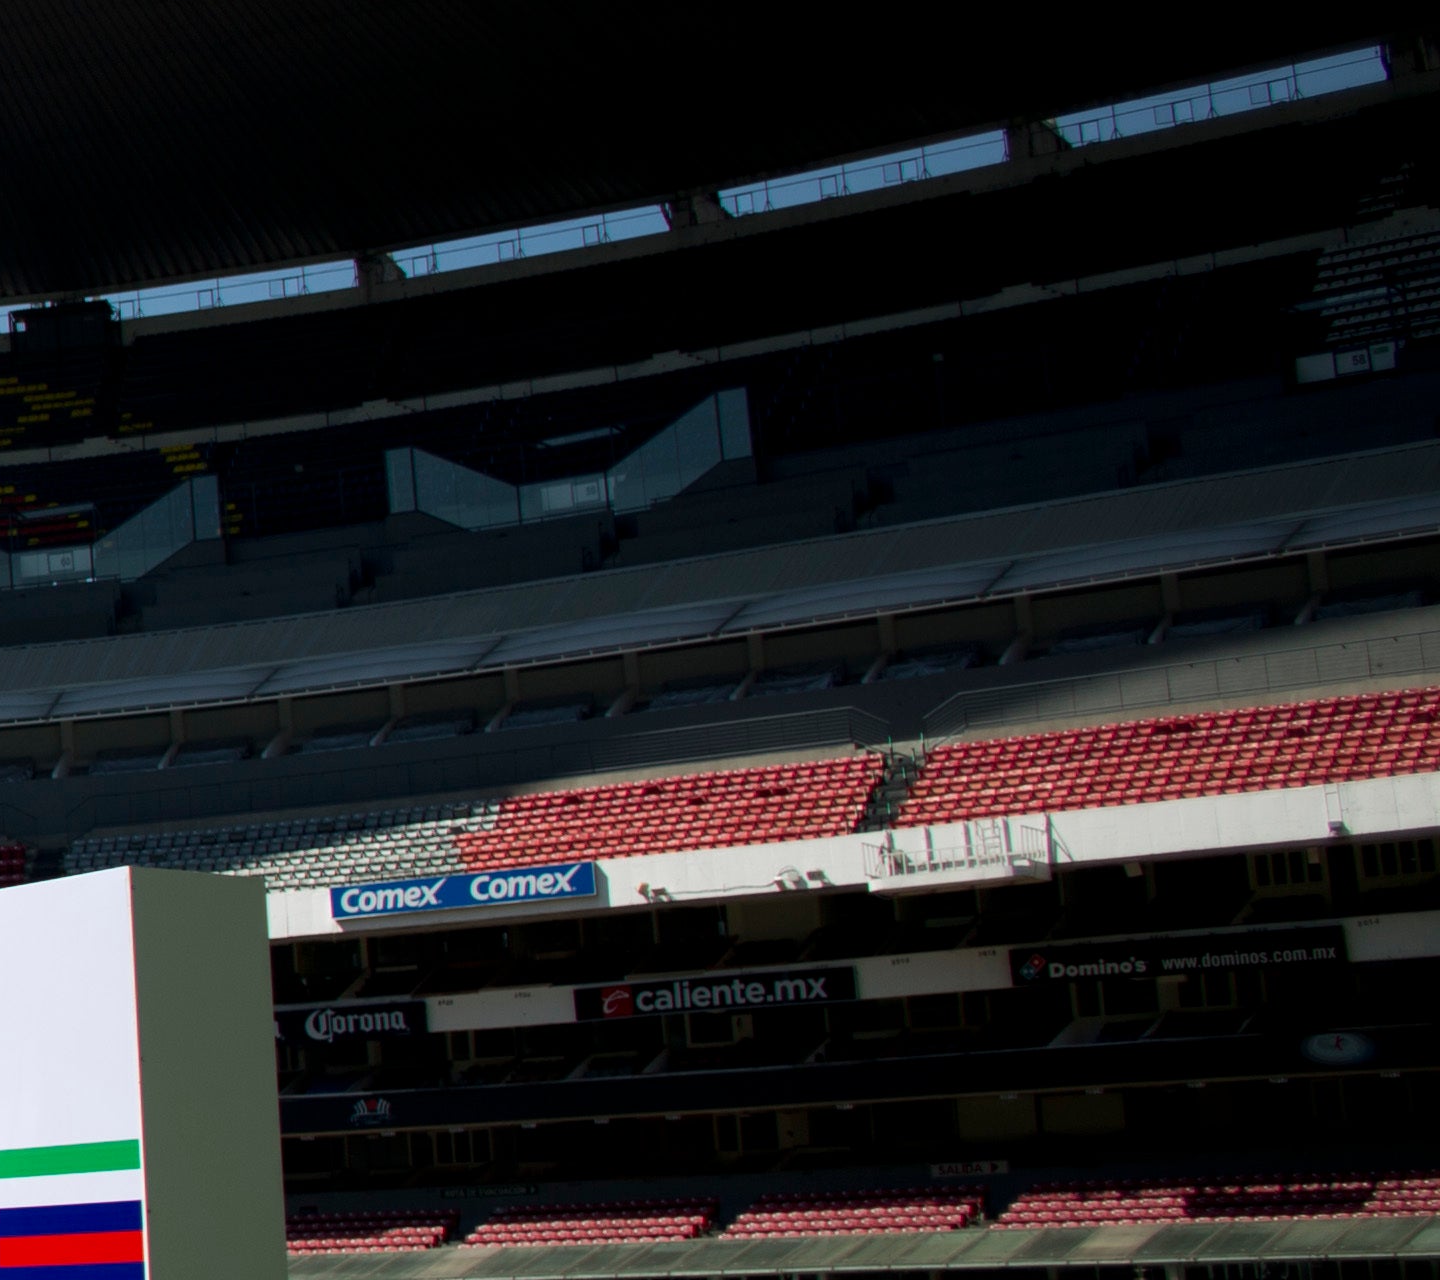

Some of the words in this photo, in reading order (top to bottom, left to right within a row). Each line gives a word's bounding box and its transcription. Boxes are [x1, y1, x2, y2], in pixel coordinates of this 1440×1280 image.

[340, 877, 447, 915] Comex
[469, 865, 580, 901] Comex
[1048, 955, 1147, 980] Domino's
[1161, 944, 1337, 972] www.dominos.com.mx
[636, 974, 830, 1014] caliente.mx
[303, 1007, 409, 1045] Corona
[938, 1163, 982, 1176] SALIDA
